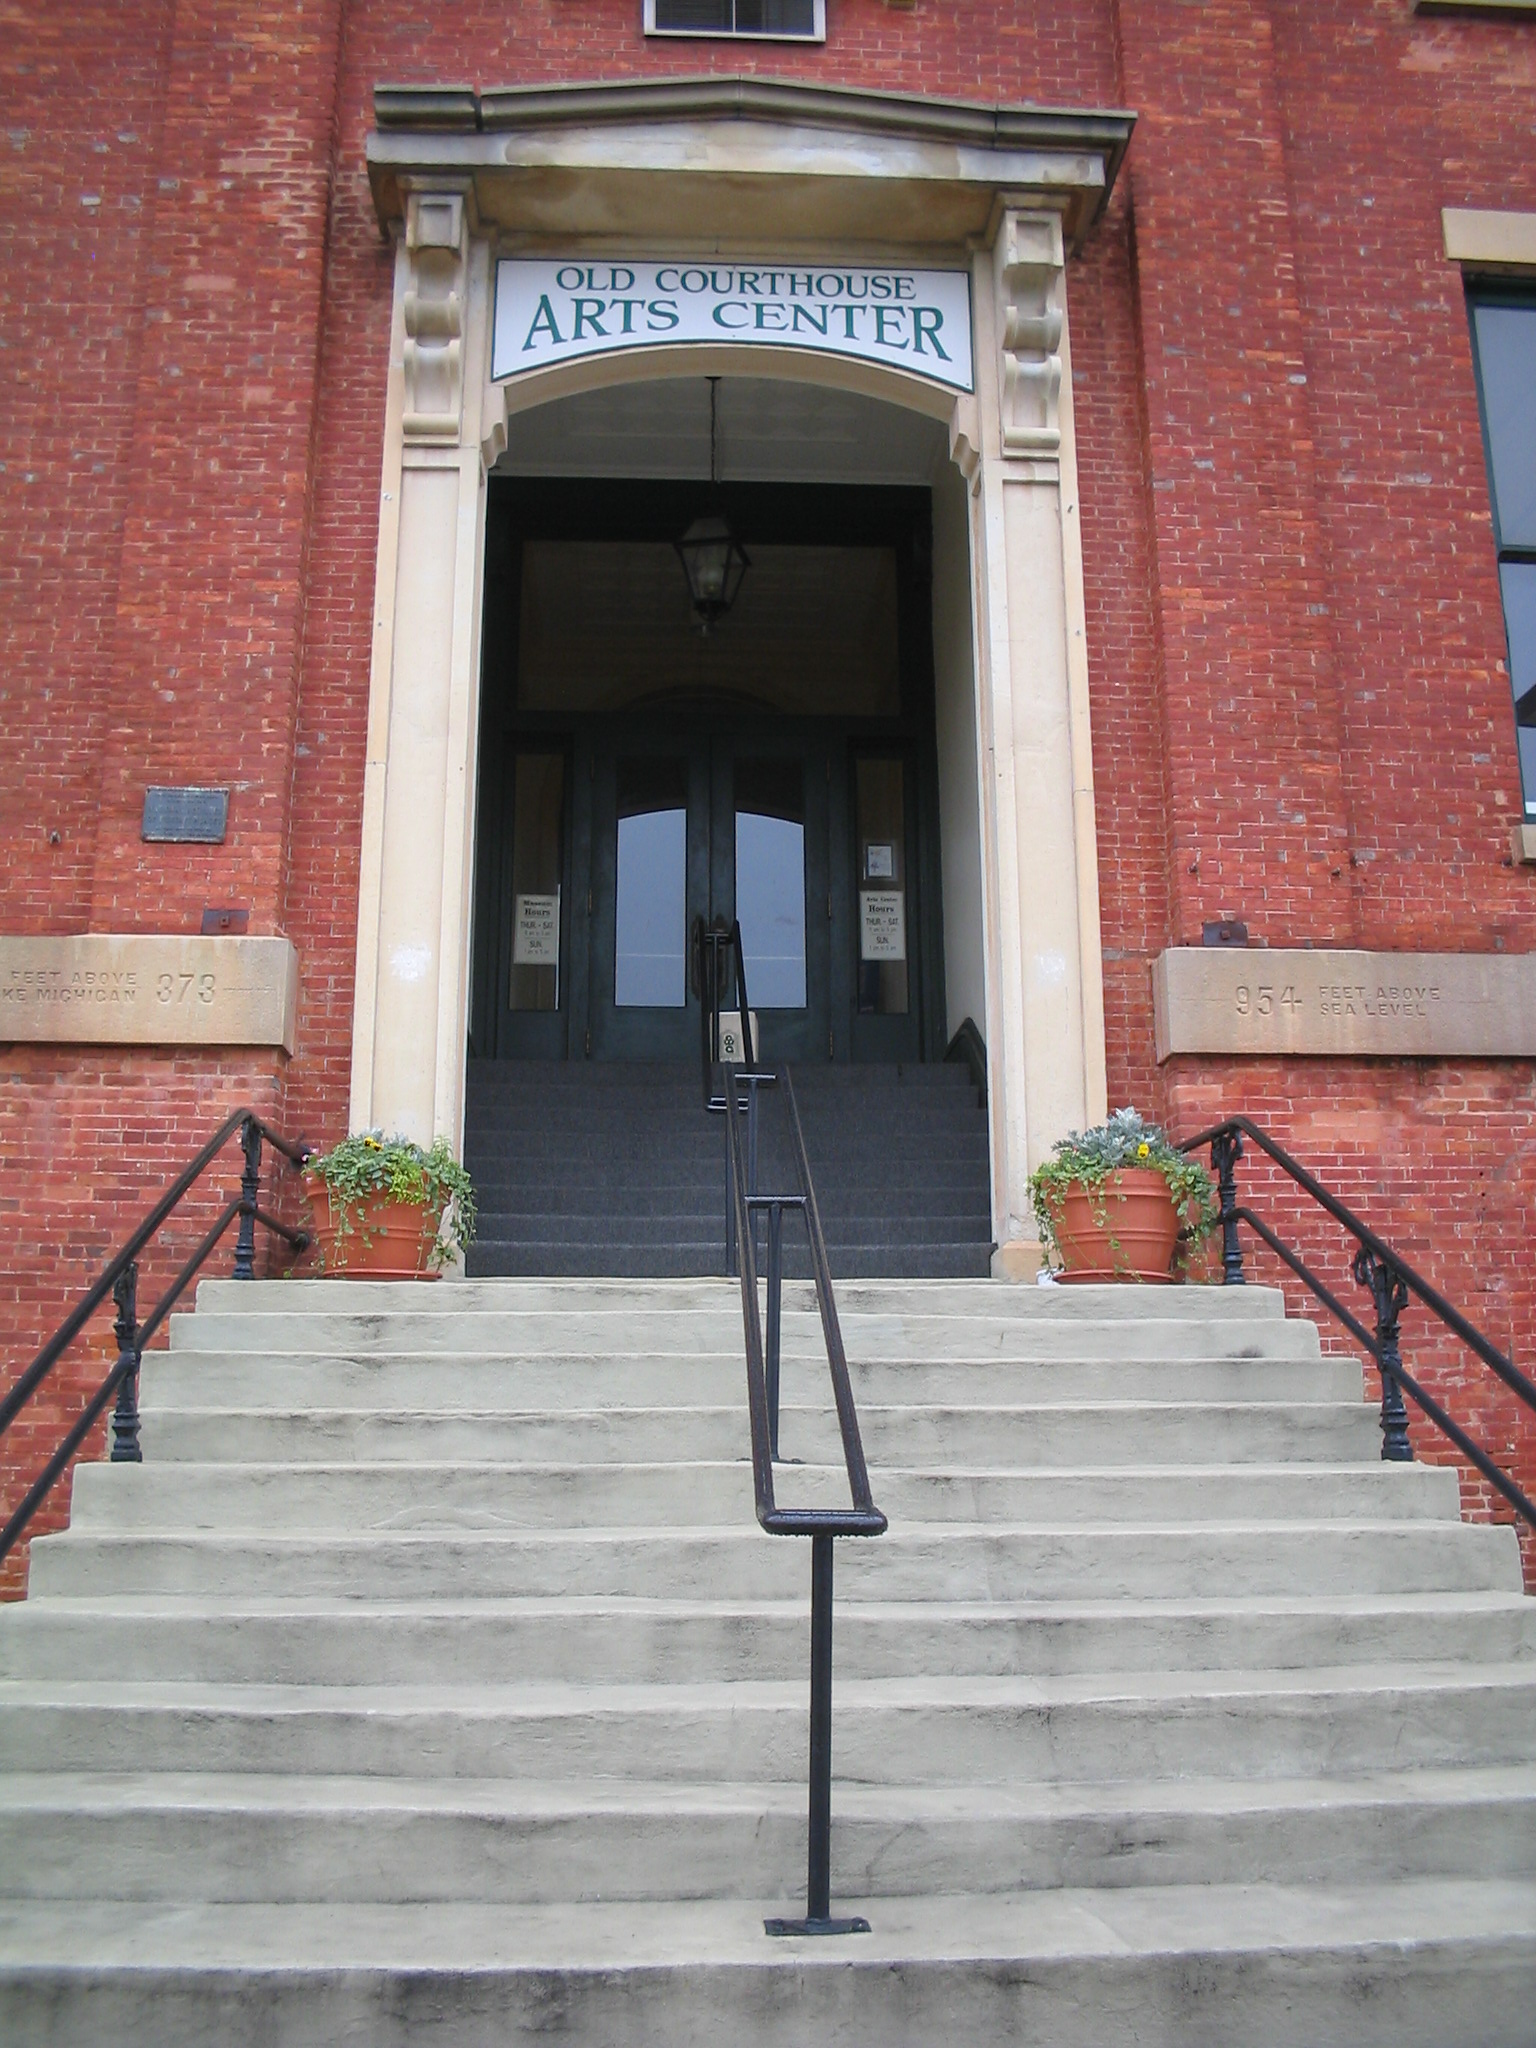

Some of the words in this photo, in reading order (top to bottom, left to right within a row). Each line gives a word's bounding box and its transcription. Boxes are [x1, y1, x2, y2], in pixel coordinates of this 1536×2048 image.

[555, 266, 636, 292] OLD
[655, 268, 917, 301] COURTHOUSE
[521, 294, 680, 352] ARTS
[712, 301, 953, 363] CENTER
[524, 907, 550, 916] Hours
[868, 904, 894, 912] Hours
[11, 971, 61, 985] FEET
[72, 971, 137, 985] ABOVE
[156, 973, 217, 1004] 373
[1318, 985, 1366, 1000] FEET
[1376, 986, 1441, 1001] ABOVE
[1235, 984, 1304, 1017] 954
[1319, 1002, 1356, 1017] SEA
[1364, 1003, 1428, 1018] LEVEL
